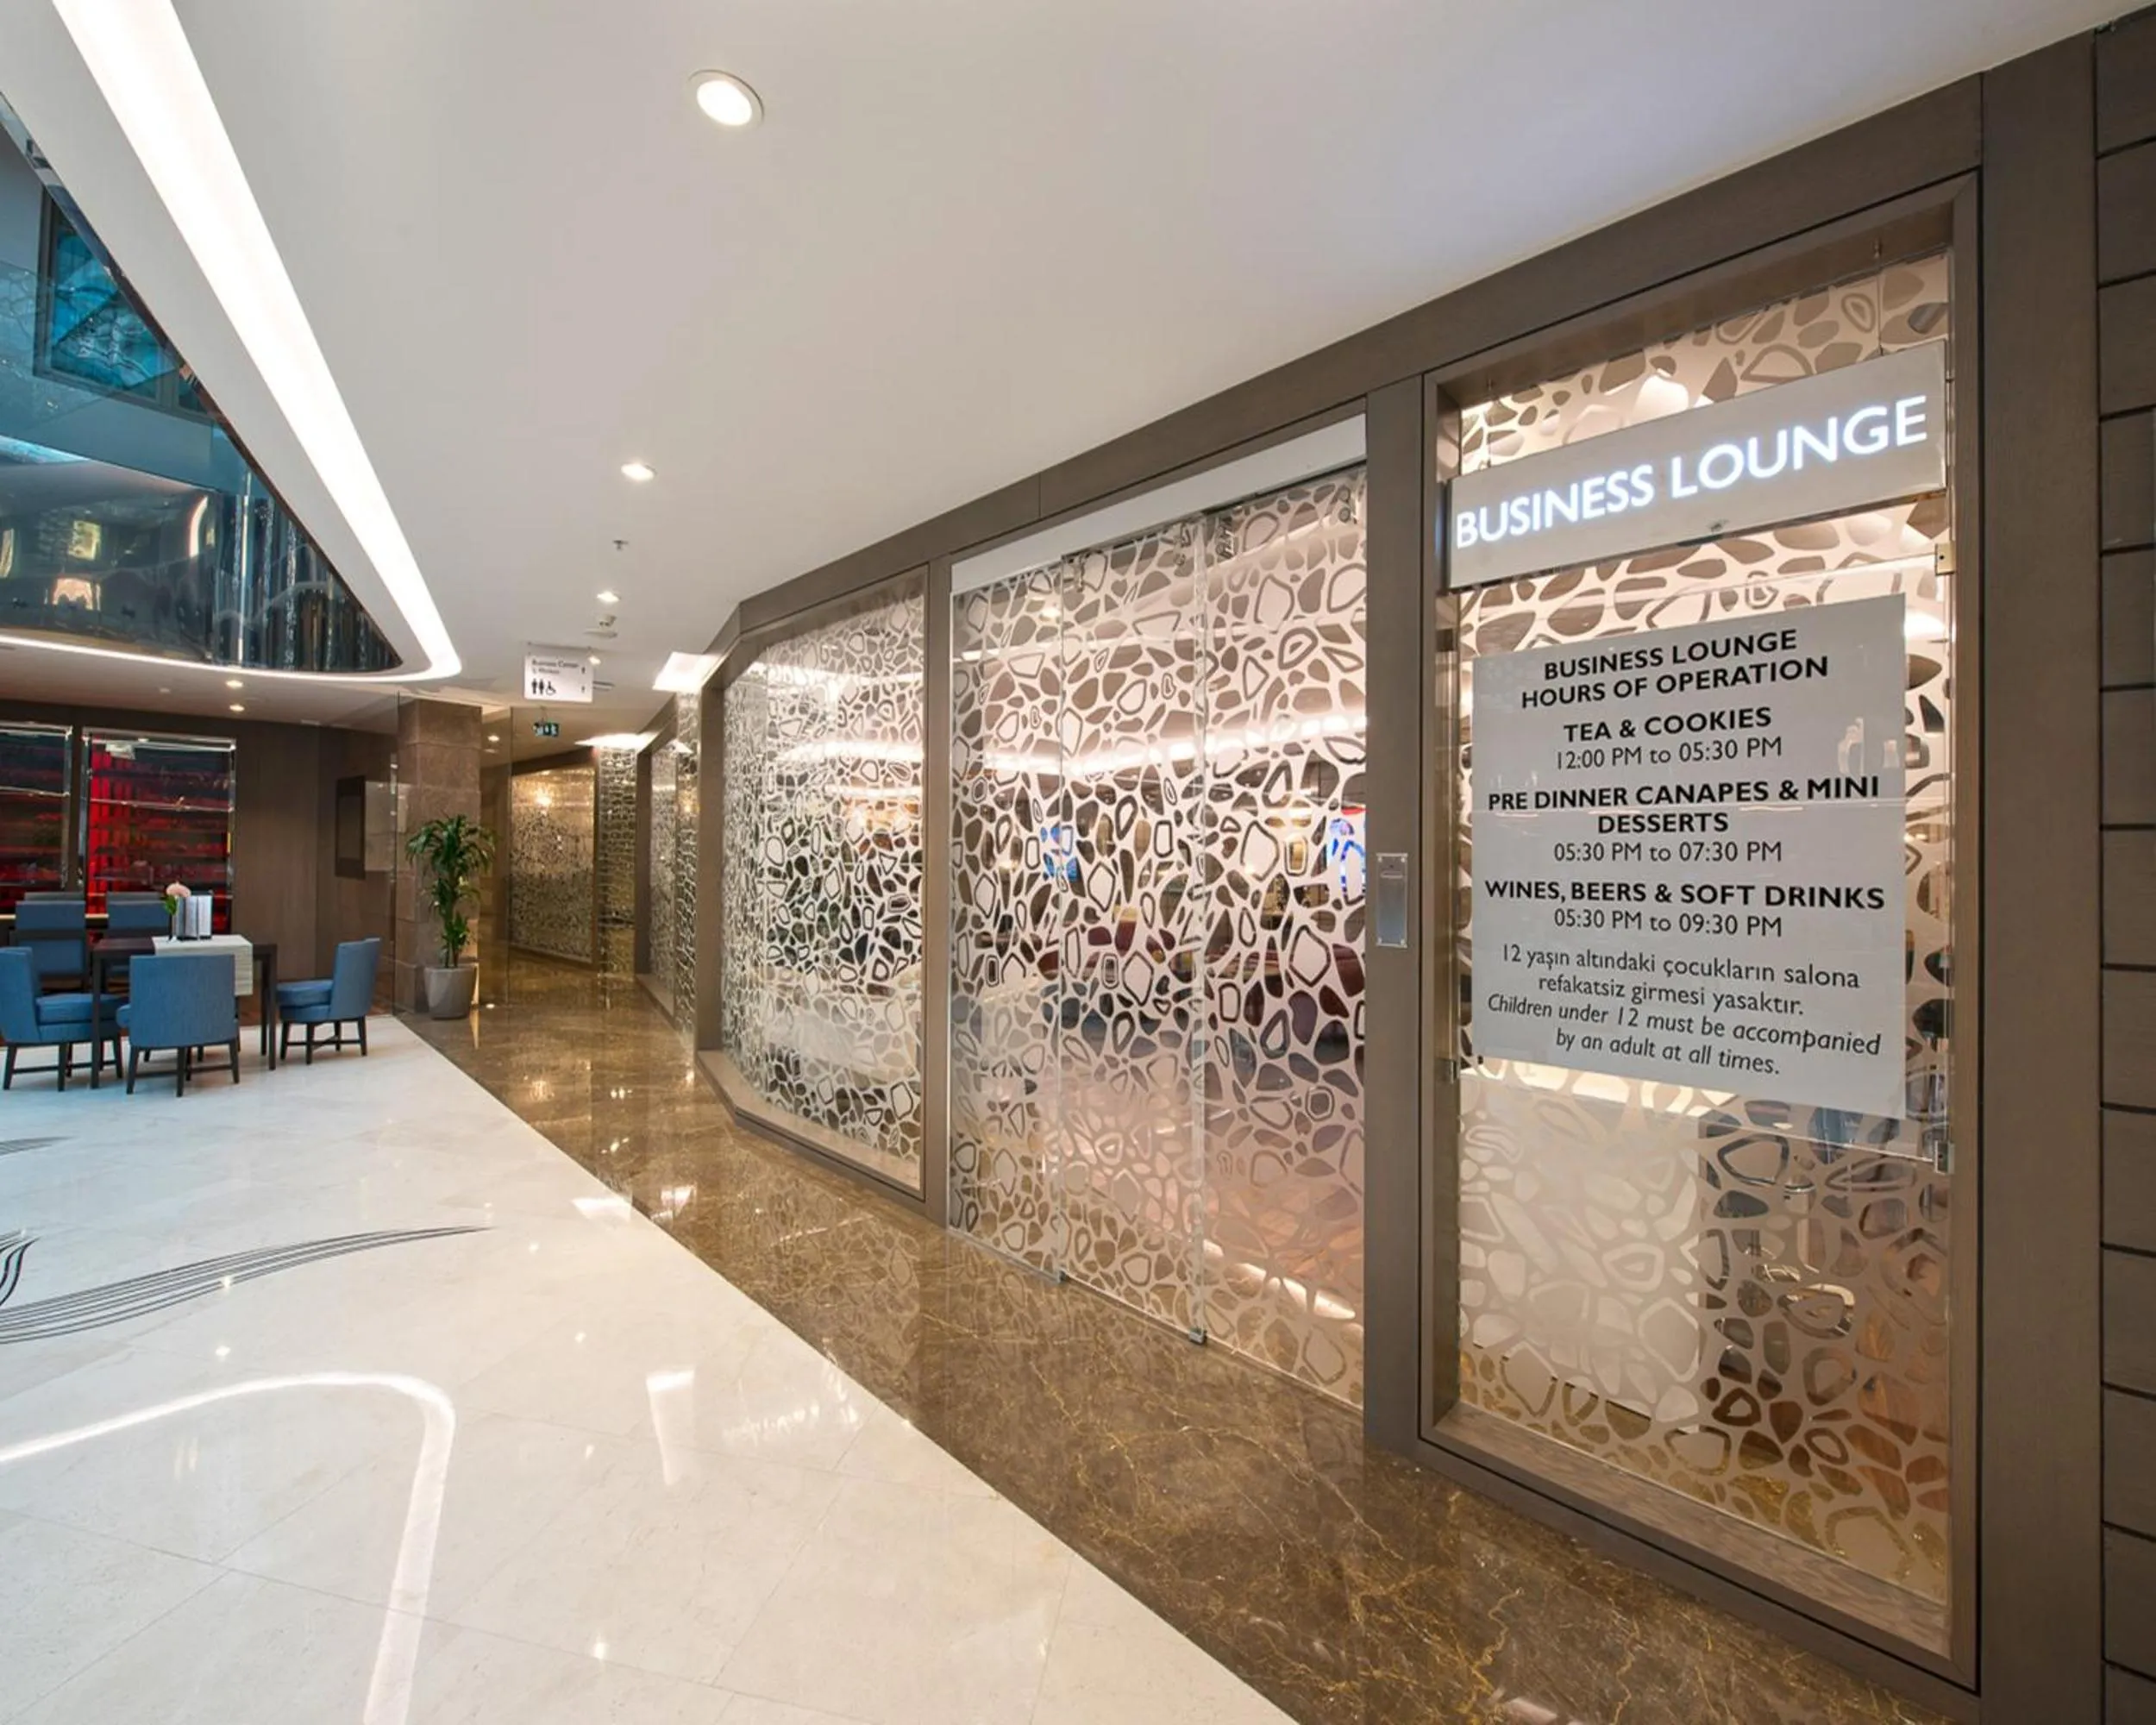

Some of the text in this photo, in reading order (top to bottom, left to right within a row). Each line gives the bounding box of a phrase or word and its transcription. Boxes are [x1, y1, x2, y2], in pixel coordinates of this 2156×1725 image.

[1456, 394, 1928, 549] BUSINESS LOUNGE
[1545, 629, 1796, 680] BUSINESS LOUNGE
[1522, 656, 1827, 709] HOURS OF OPERATION
[1564, 707, 1771, 742] TEA & COOKIES
[1557, 737, 1782, 769] 12:00 PM to 05:30 PM
[1489, 776, 1878, 810] PRE DINNER CANAPES & MINI
[1599, 812, 1728, 833] DESSERTS
[1555, 842, 1782, 862] 05:30 PM to 07:30 PM
[1485, 881, 1884, 909] WINES, BEERS & SOFT DRINKS
[1555, 908, 1782, 937] 05:30 PM to 09:30 PM
[1503, 944, 1860, 988] 12 yaşın altındaki çocukların salona
[1539, 974, 1803, 1015] refakatsiz girmesi yasaktır.
[1489, 994, 1882, 1056] Children under 12 must be accompanied
[1557, 1028, 1779, 1075] by an adult at all times.
